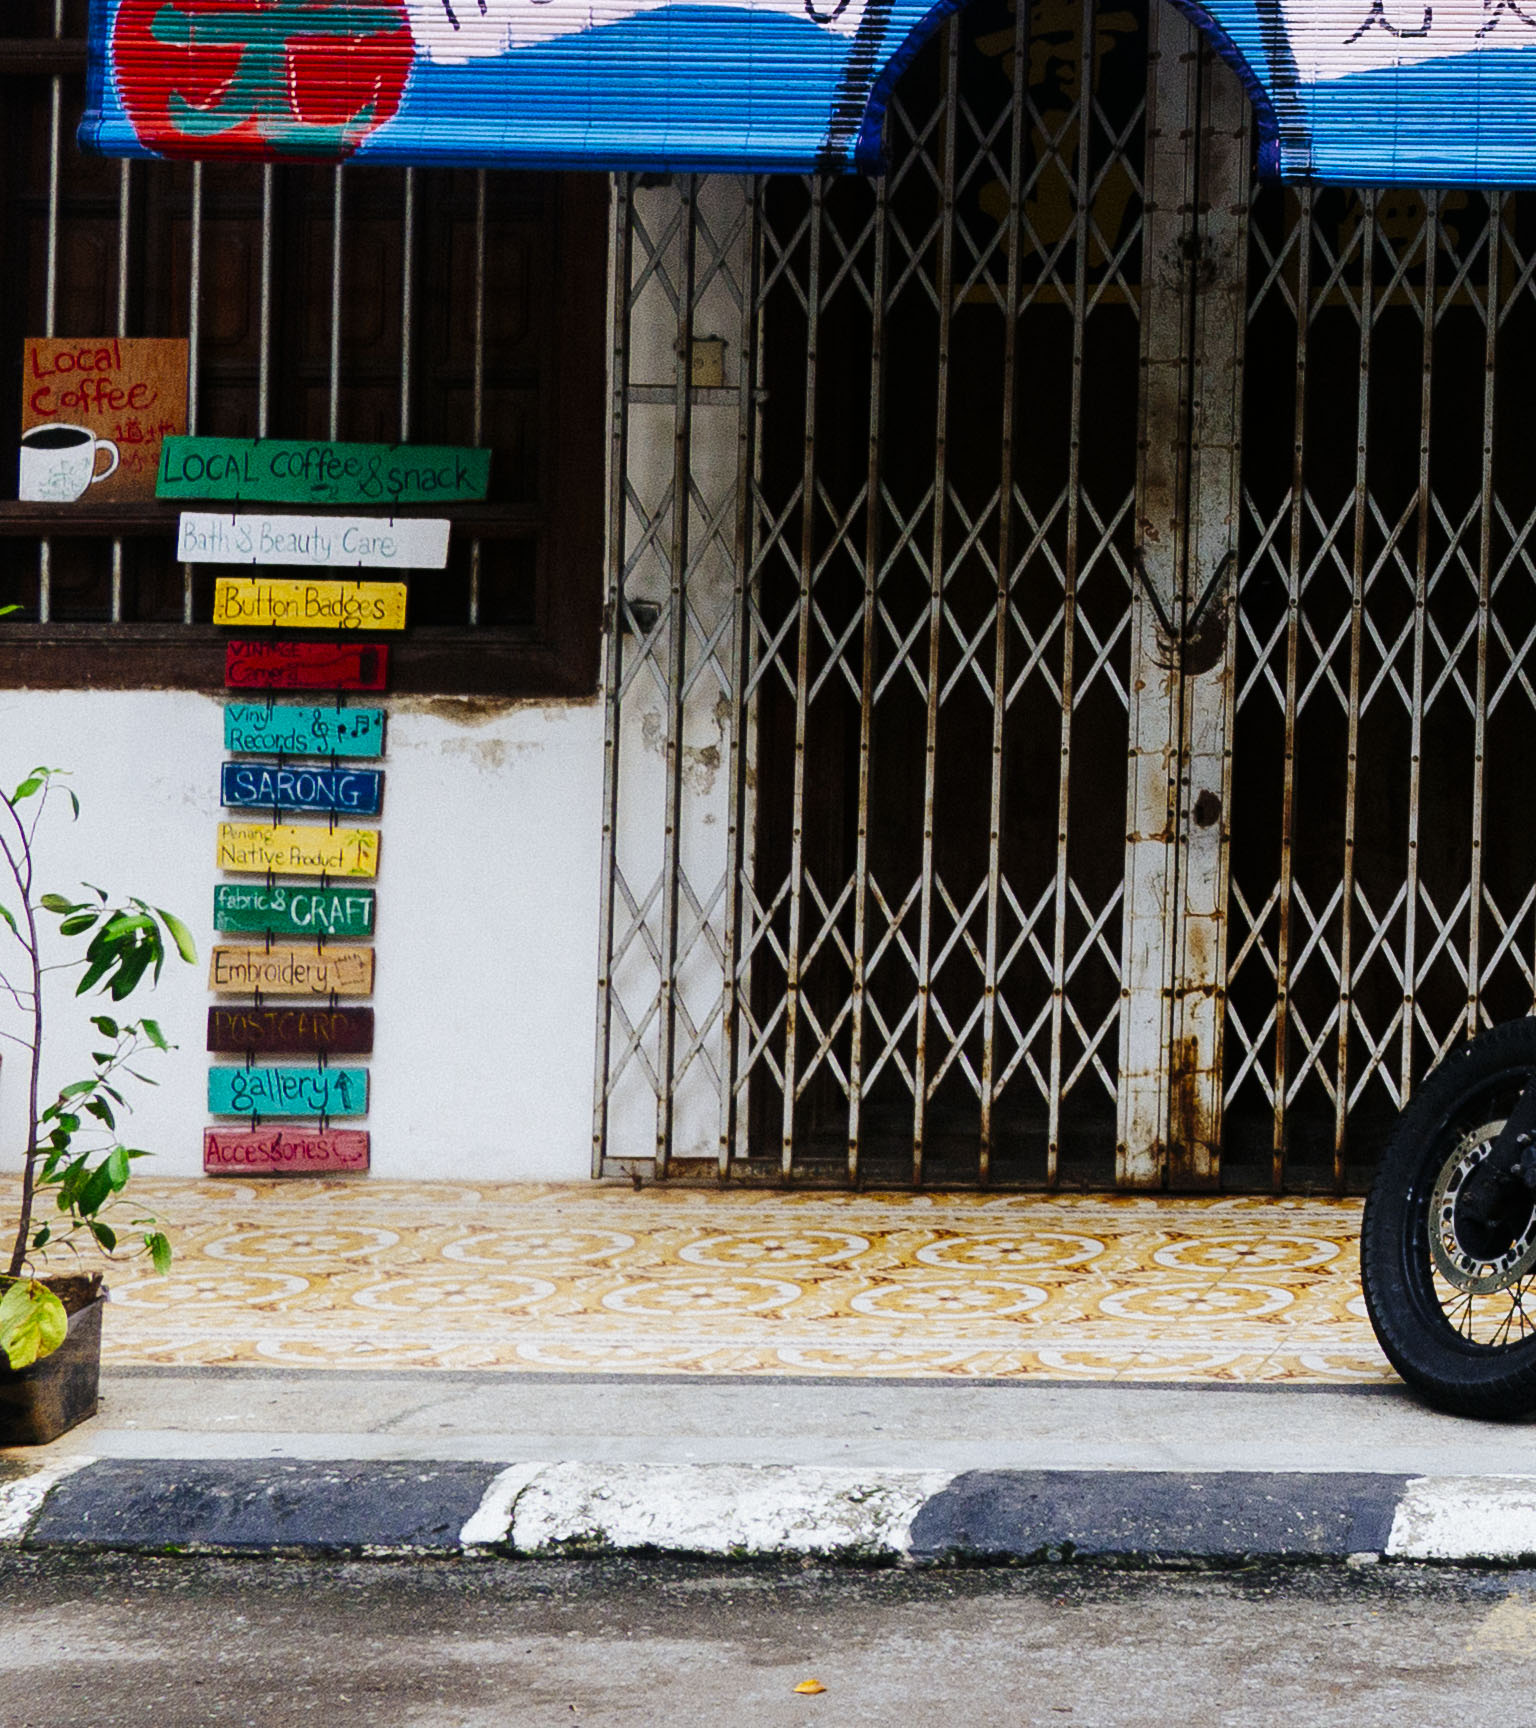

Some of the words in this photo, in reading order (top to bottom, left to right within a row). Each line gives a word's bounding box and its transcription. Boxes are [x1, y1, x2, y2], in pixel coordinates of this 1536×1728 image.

[32, 339, 122, 379] Local
[164, 447, 260, 483] LOCAL
[387, 454, 478, 495] snack
[183, 522, 230, 552] Bath
[260, 526, 331, 562] Beauty
[342, 527, 398, 558] Care
[224, 586, 298, 618] Button
[305, 586, 386, 629] Badges
[228, 706, 273, 731] Vinyl
[230, 727, 308, 753] Records
[234, 771, 361, 806] SARONG
[222, 824, 274, 846] Penang
[221, 845, 285, 865] Native
[289, 846, 344, 868] Product
[290, 895, 374, 927] CRAFT
[214, 950, 329, 992] Embroidery
[214, 1011, 348, 1043] POSTCARD
[230, 1069, 330, 1112] gallery
[206, 1134, 330, 1163] Accessories
